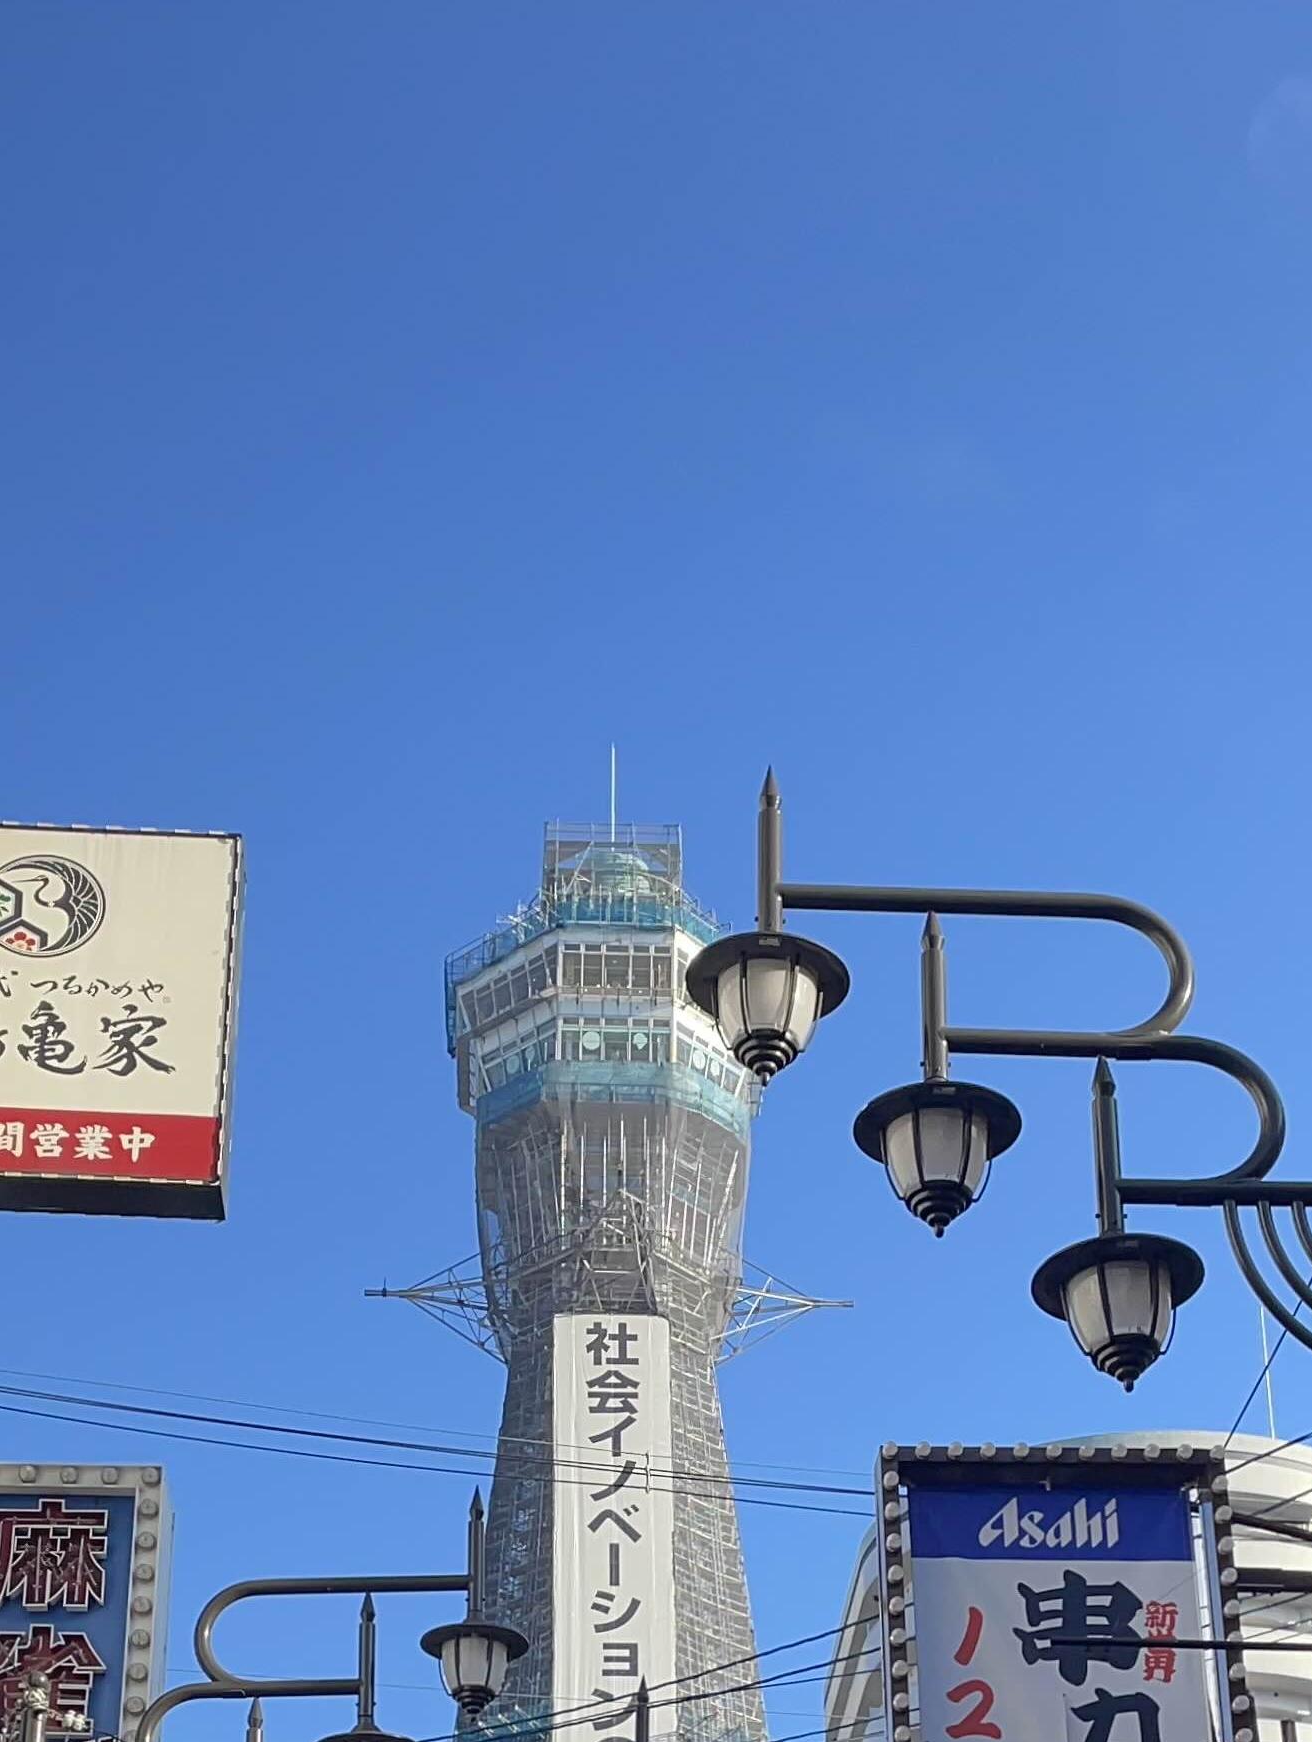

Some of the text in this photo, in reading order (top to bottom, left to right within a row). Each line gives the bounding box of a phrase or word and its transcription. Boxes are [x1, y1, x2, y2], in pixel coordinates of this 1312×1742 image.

[30, 975, 164, 1003] つるかめや
[978, 1496, 1119, 1550] Asahi
